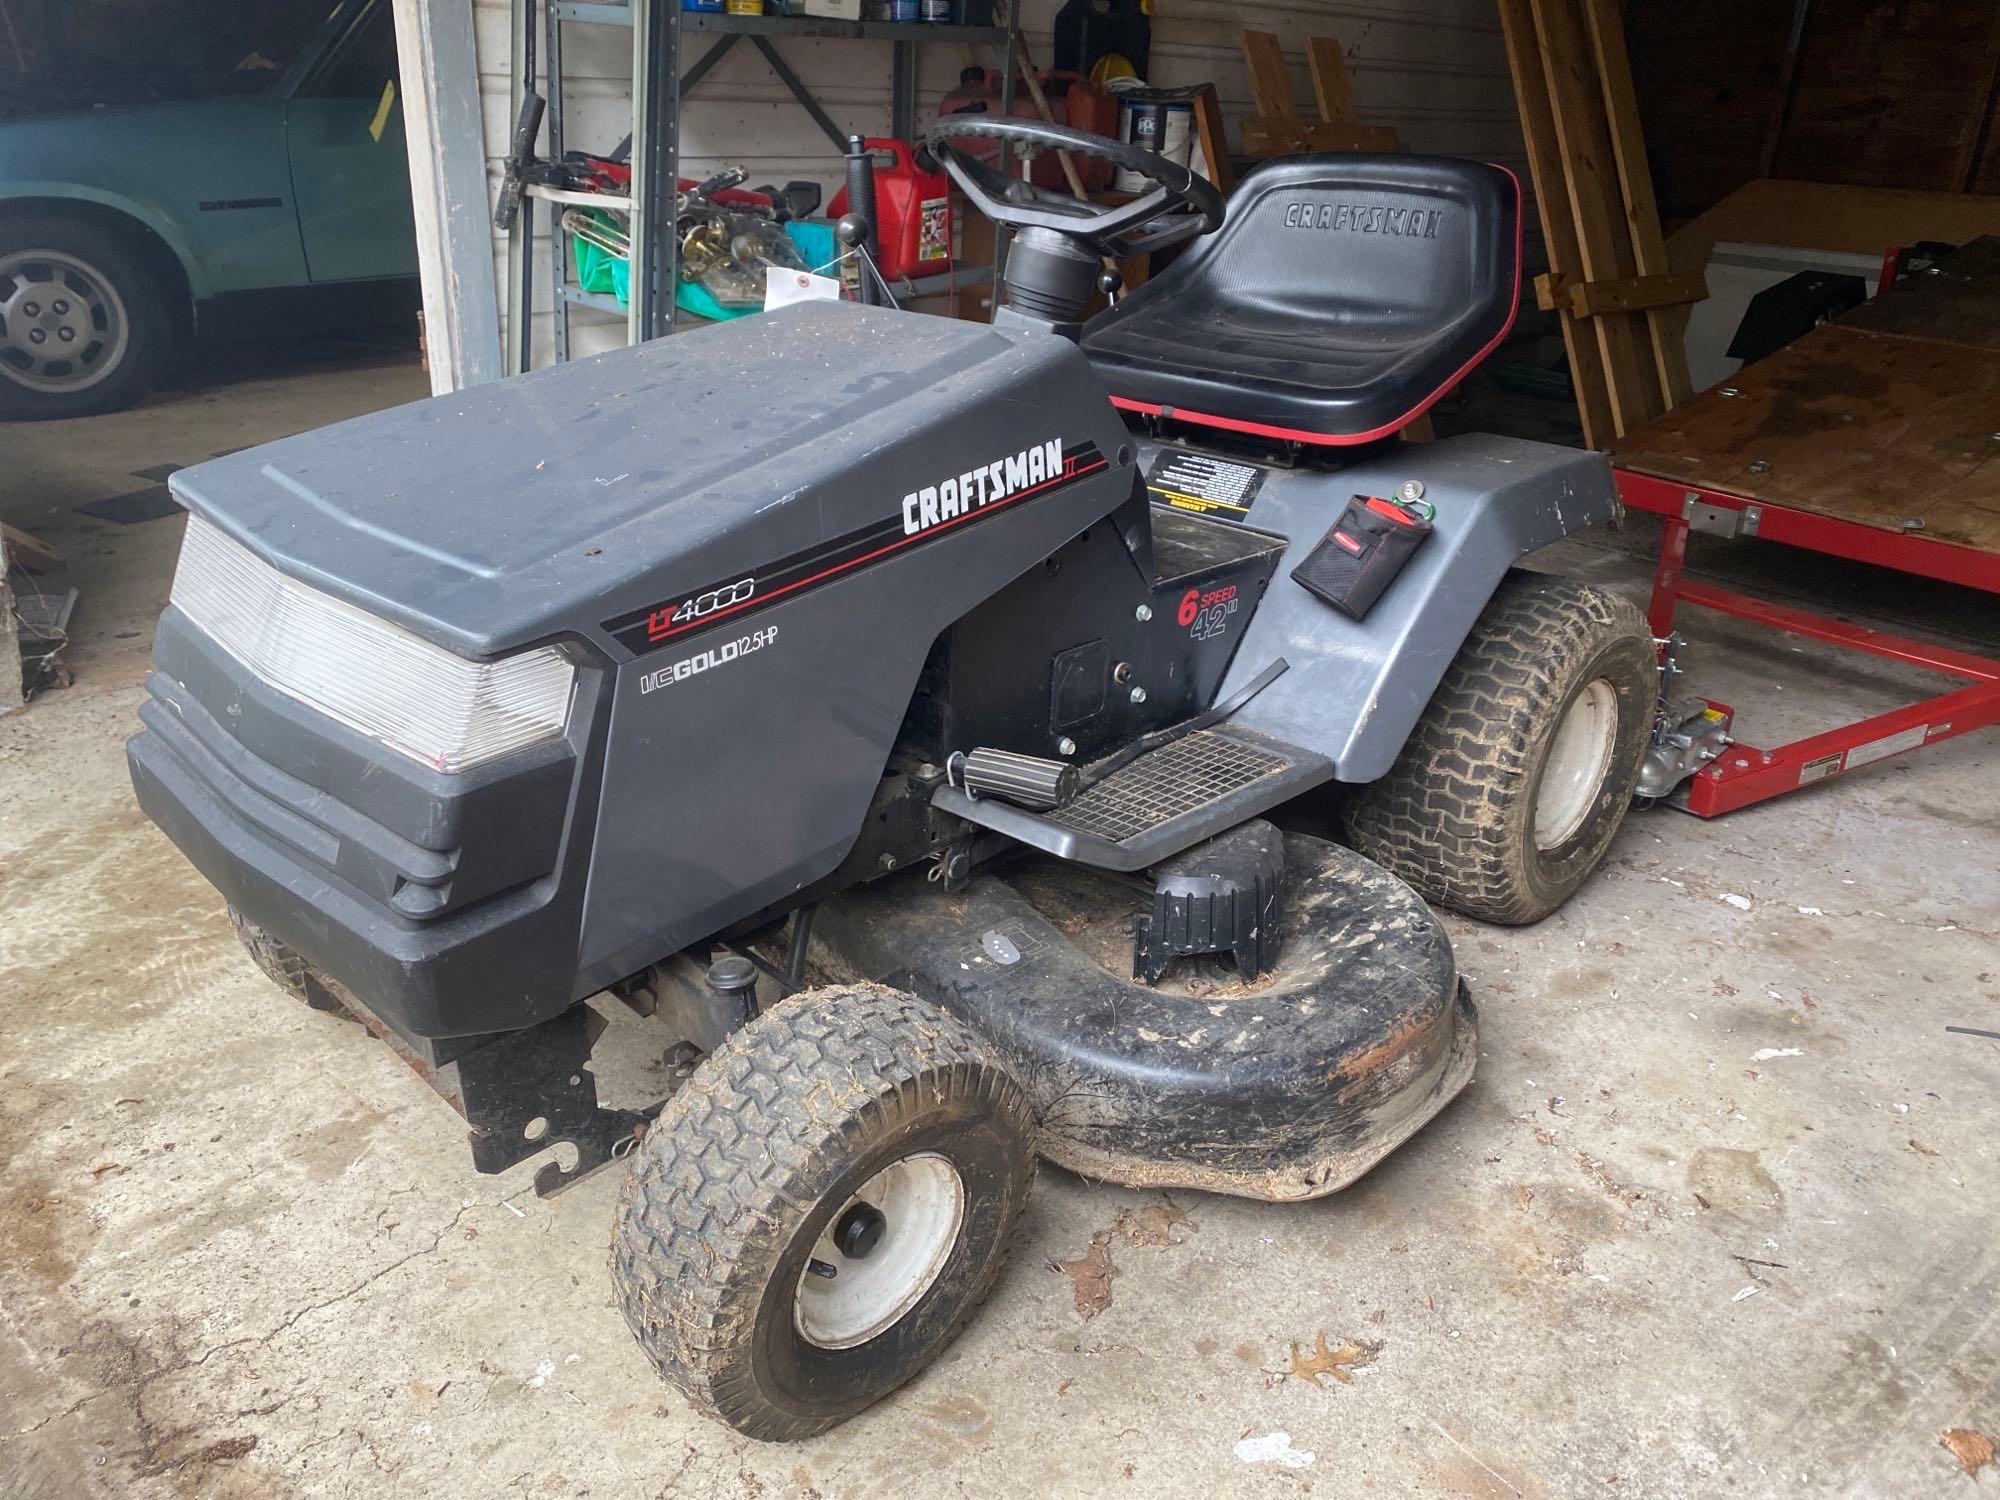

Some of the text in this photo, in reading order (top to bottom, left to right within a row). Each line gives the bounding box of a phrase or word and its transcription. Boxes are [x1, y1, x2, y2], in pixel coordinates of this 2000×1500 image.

[1284, 203, 1442, 239] CRAFTSMAN
[902, 437, 1063, 536] CRAFTSMAN
[1178, 584, 1237, 627] 6 SPEED
